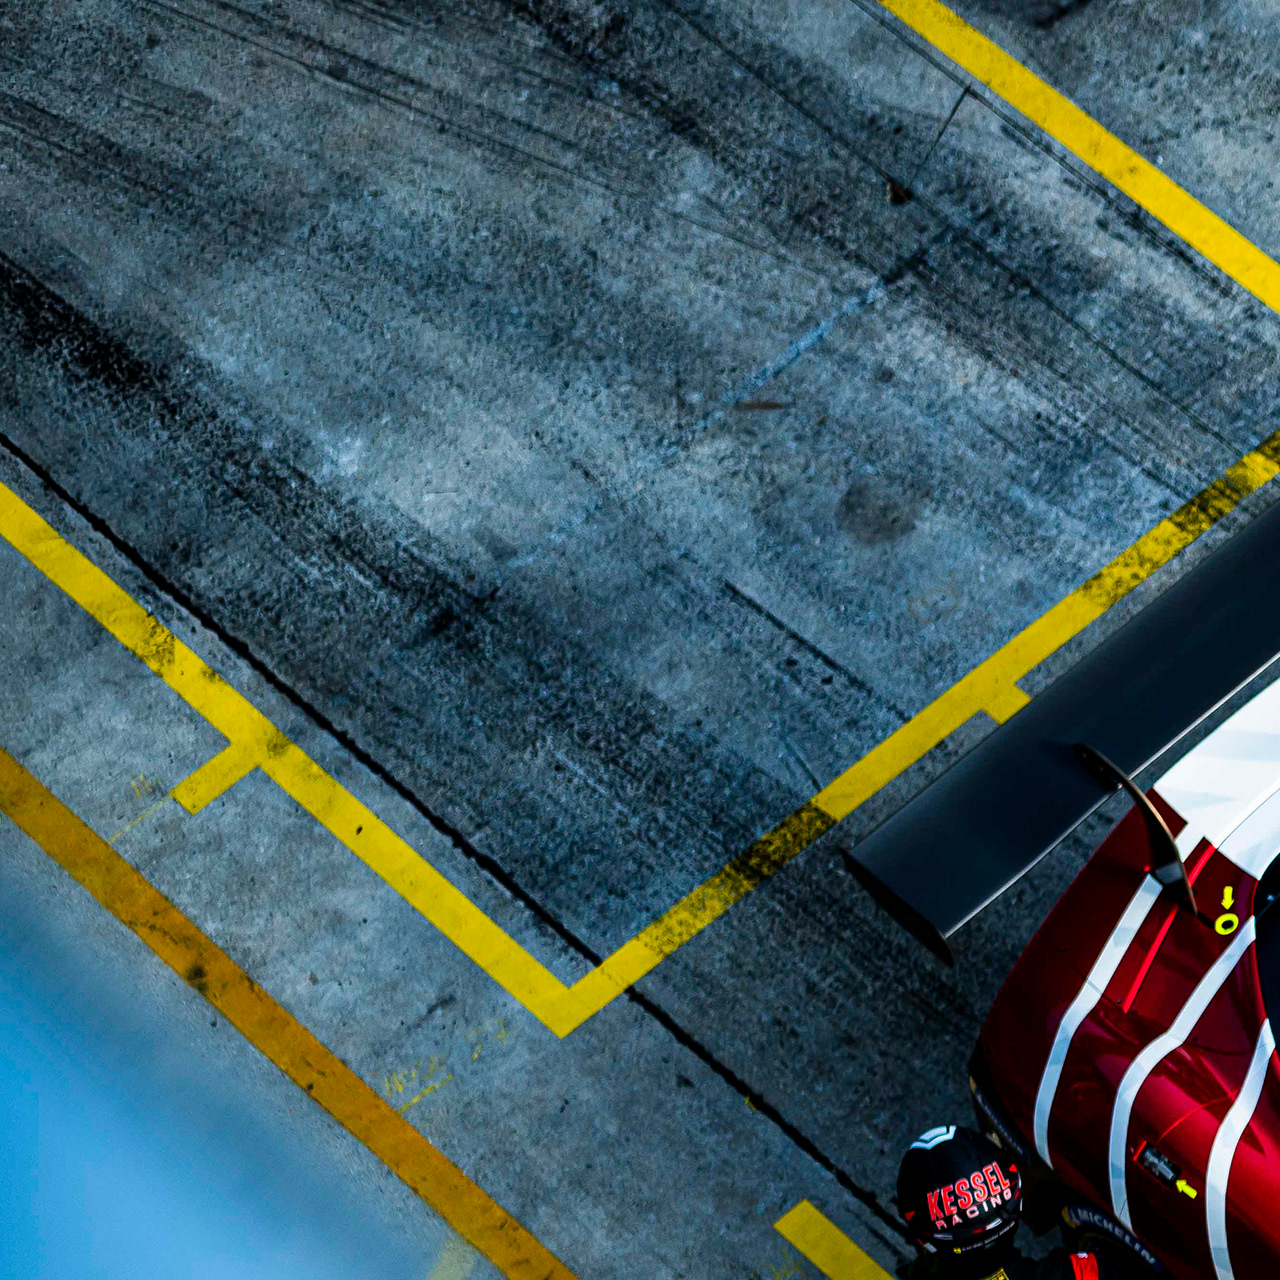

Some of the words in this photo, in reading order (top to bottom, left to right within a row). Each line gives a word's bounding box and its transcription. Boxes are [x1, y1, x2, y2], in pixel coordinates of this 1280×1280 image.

[927, 1161, 1011, 1221] KESSEL
[935, 1187, 1012, 1230] RACING
[1077, 1207, 1156, 1265] MICHELIN
